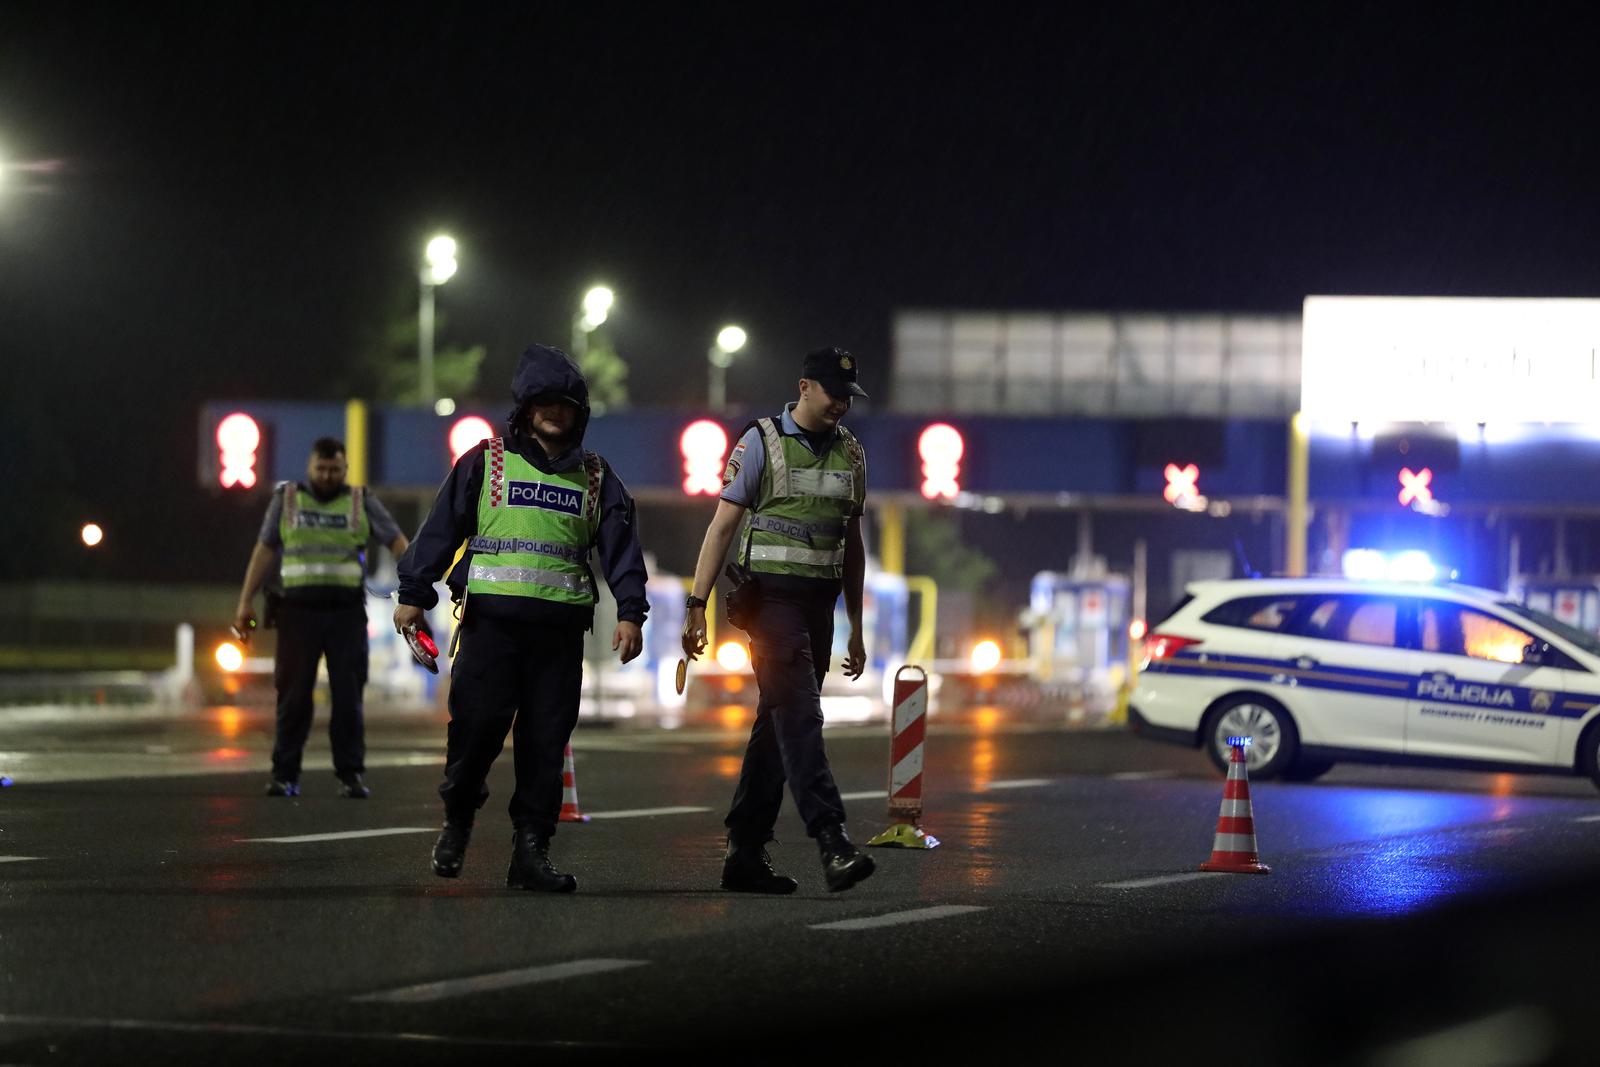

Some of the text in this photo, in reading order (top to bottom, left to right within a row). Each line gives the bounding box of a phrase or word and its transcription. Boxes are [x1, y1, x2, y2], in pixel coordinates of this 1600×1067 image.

[511, 486, 579, 509] POLICIJA
[517, 541, 563, 557] POLICIJA
[1417, 679, 1515, 707] POLICIJA
